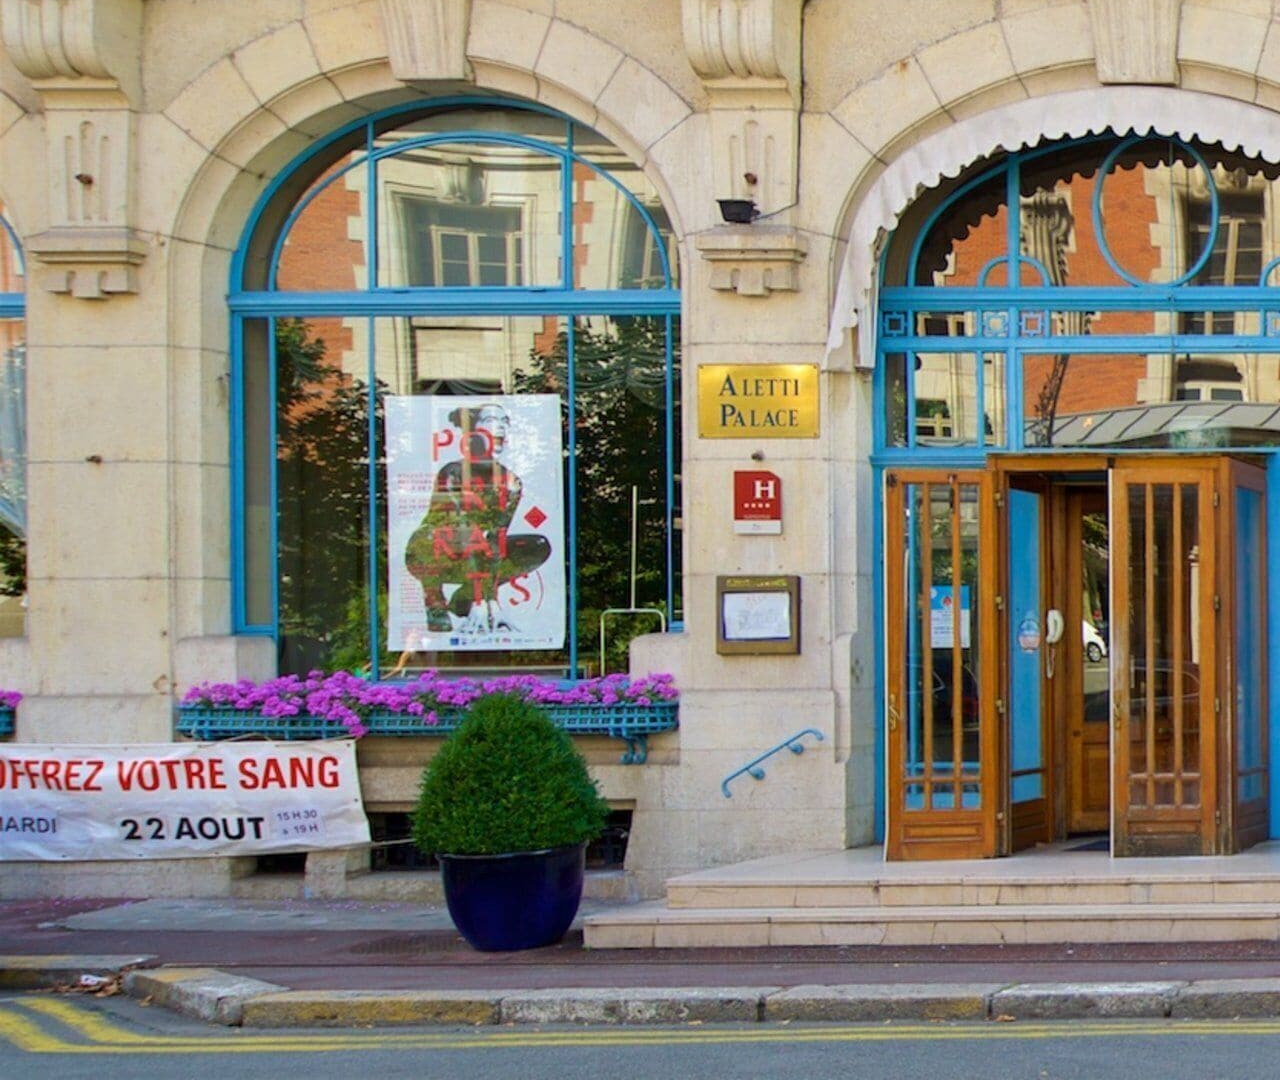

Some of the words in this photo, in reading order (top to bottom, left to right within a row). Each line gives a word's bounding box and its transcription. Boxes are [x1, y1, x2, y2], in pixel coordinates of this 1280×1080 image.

[719, 373, 799, 396] ALETTI
[720, 403, 800, 427] PALACE
[753, 480, 776, 499] H
[117, 759, 227, 792] VOTRE
[239, 756, 340, 790] SANG
[0, 816, 57, 834] ARDI
[121, 817, 166, 841] 22
[175, 816, 265, 841] AOUT
